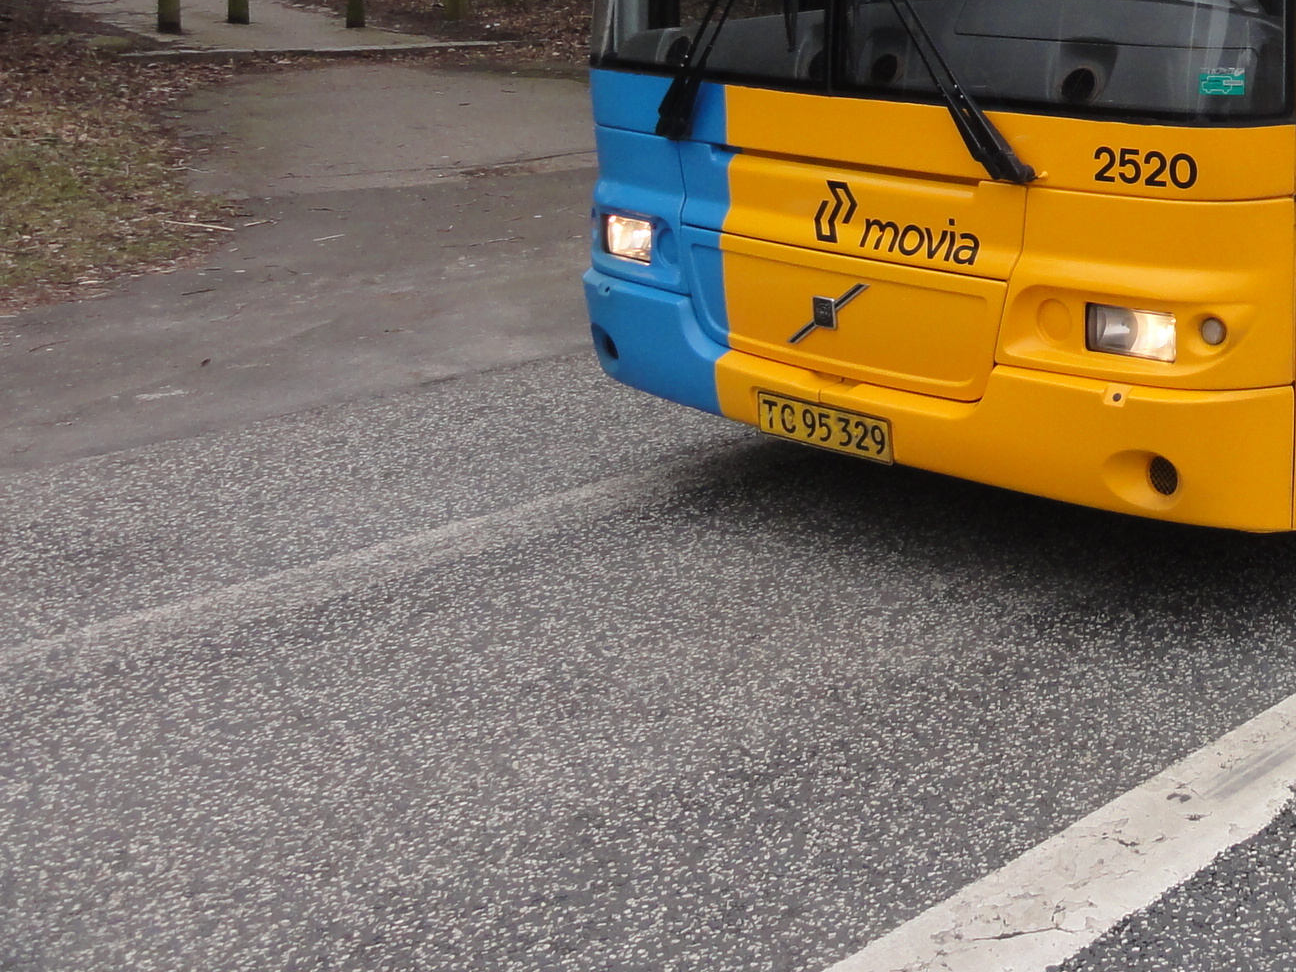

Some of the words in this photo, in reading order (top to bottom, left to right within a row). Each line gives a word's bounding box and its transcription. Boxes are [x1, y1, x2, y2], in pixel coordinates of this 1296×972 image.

[1093, 146, 1198, 189] 2520
[859, 218, 980, 266] movia
[762, 399, 796, 434] TC
